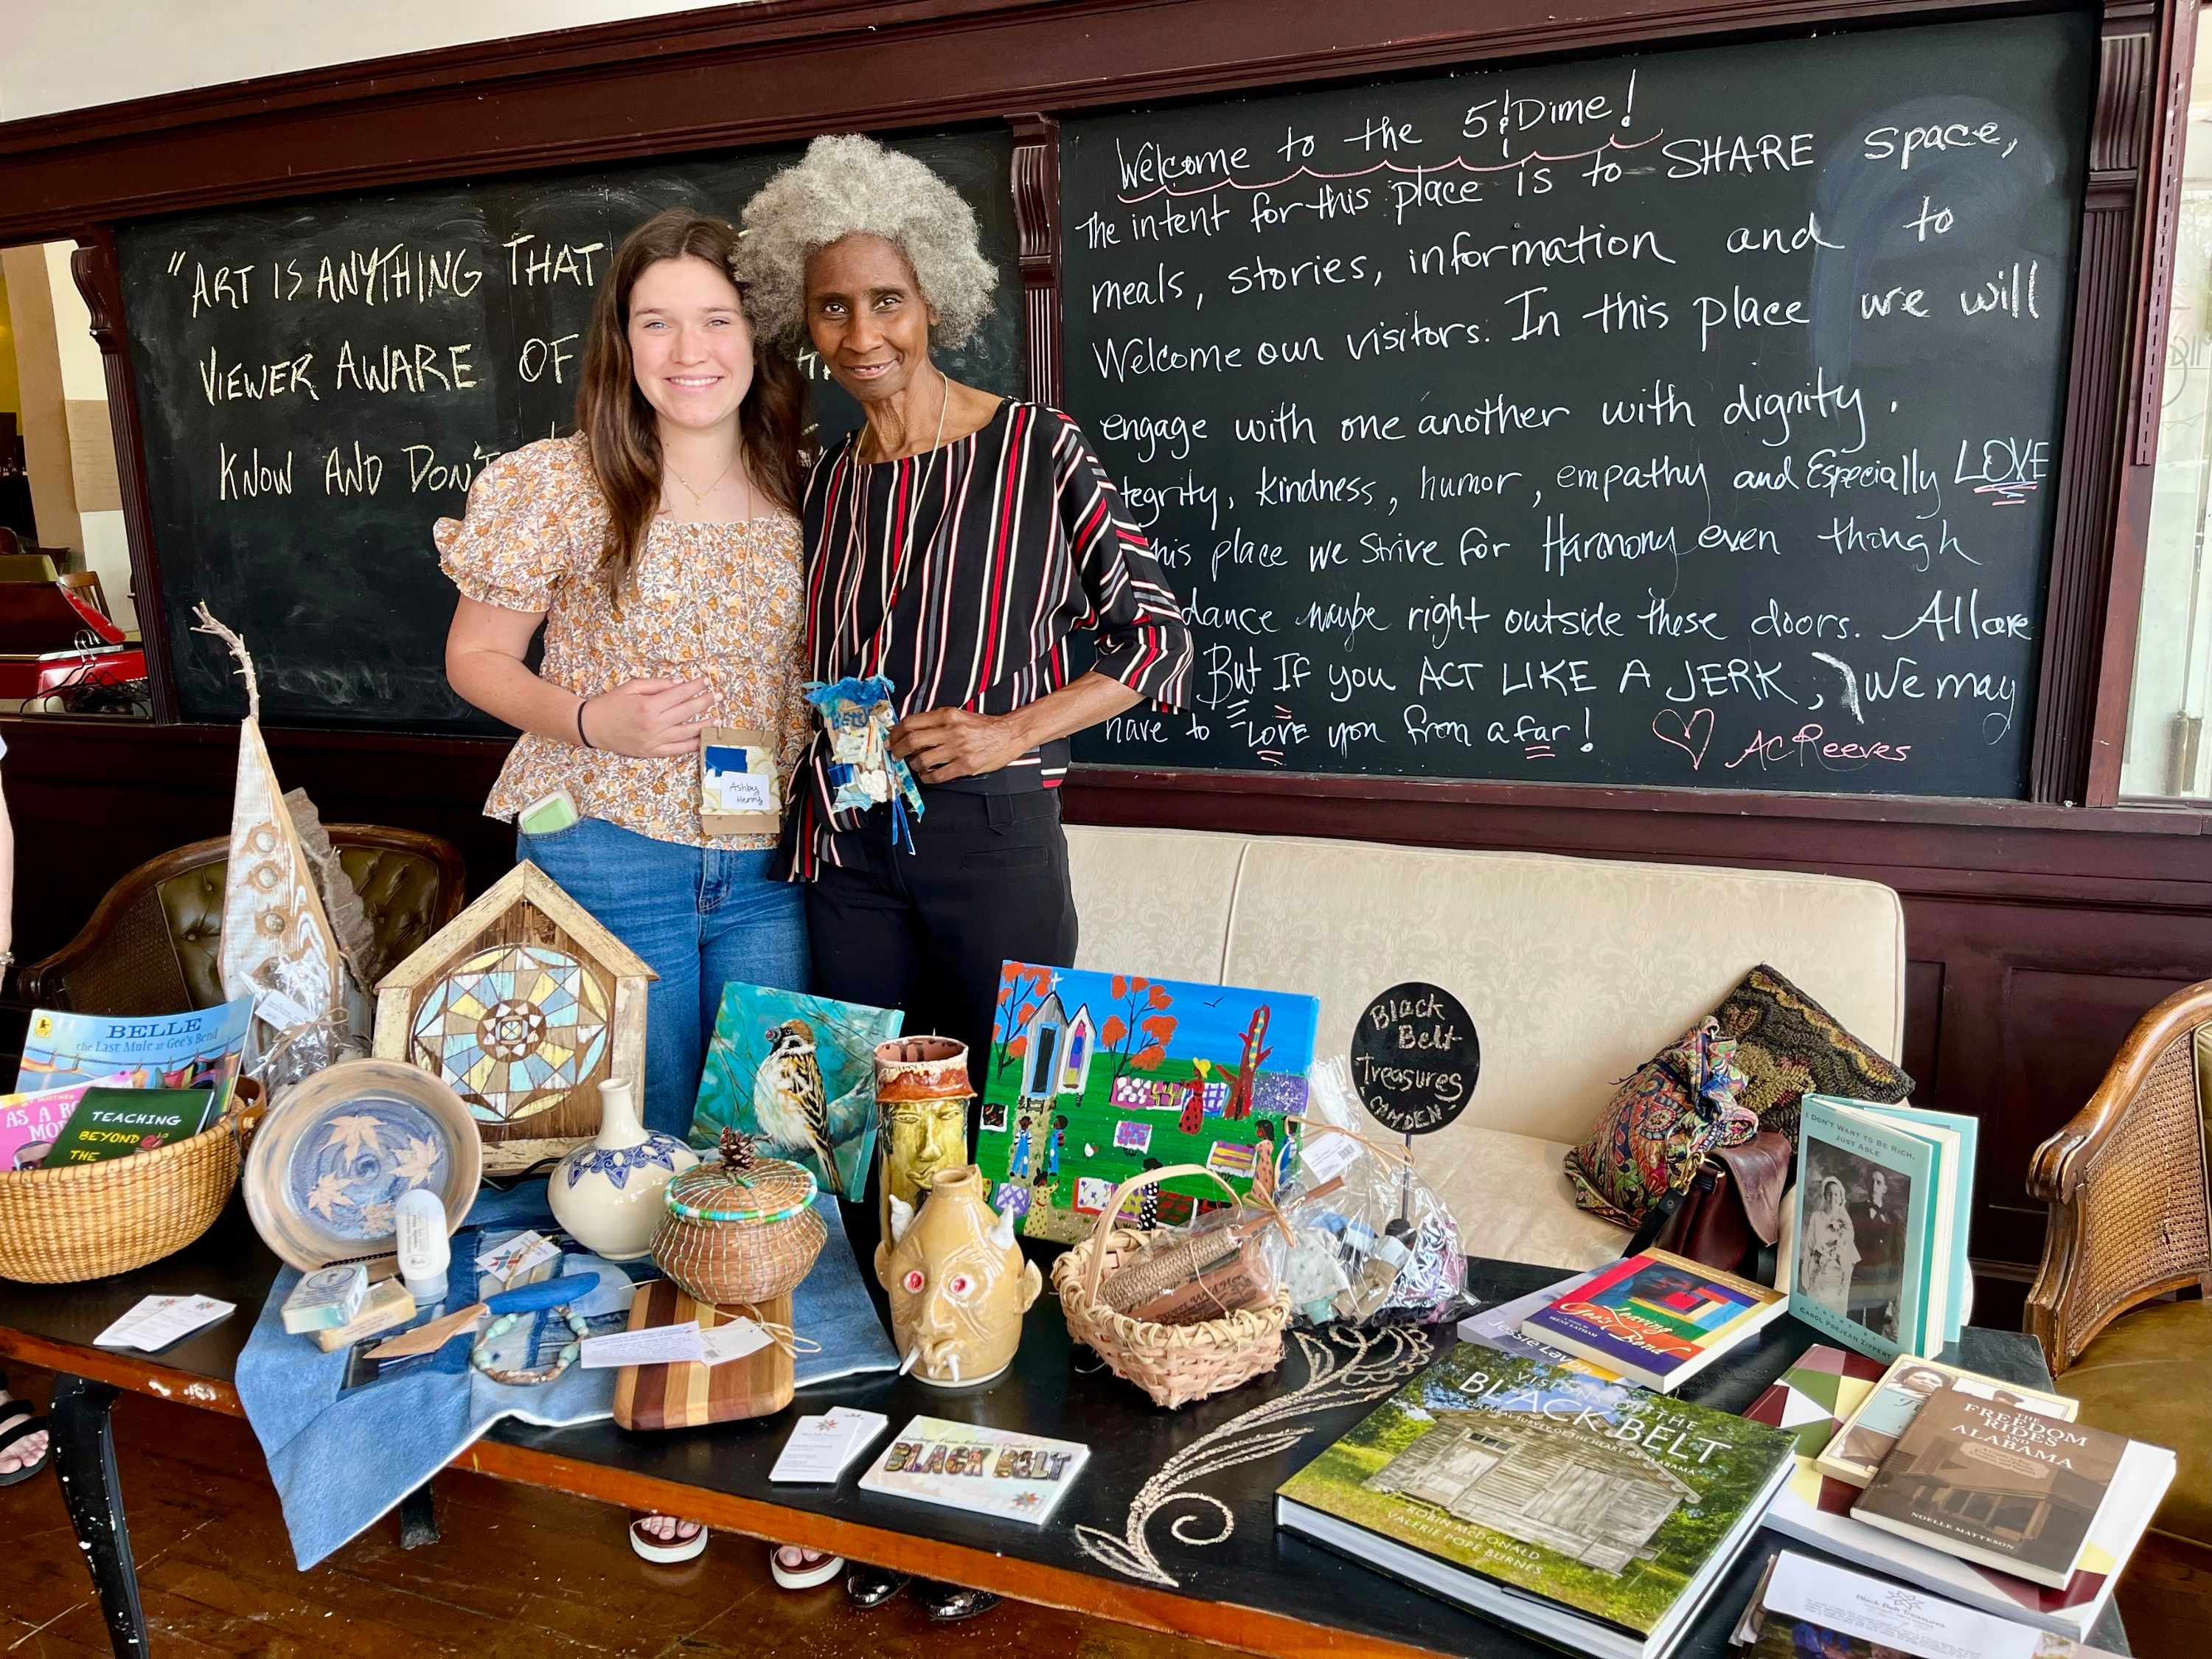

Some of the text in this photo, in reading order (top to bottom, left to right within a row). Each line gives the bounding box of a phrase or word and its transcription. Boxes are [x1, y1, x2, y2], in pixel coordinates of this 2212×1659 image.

[1116, 137, 1251, 189] Welcome
[1277, 126, 1315, 162] to
[1343, 116, 1423, 153] the
[1132, 193, 1231, 241] intent
[1251, 201, 1302, 234] for
[1295, 183, 1371, 223] this
[1395, 164, 1484, 226] place
[1517, 161, 1553, 197] is
[1582, 150, 1622, 187] to
[1662, 133, 1815, 180] SHARE
[274, 260, 301, 302] IS
[317, 243, 483, 306] ANYTHING
[503, 234, 605, 287] THAT
[1091, 194, 1955, 311] meals, stories, information and to
[1091, 337, 1243, 383] Welcome
[1347, 310, 1492, 361] visitors.
[1504, 286, 1561, 342] In
[1582, 291, 1672, 335] this
[1692, 285, 1811, 352] place
[1861, 286, 1931, 319] we
[1959, 260, 2040, 319] will
[198, 333, 580, 407] VIEWER AWARE OF
[1099, 360, 1899, 462] engage with one another with dignity.
[220, 442, 293, 501] KNOW
[325, 440, 383, 497] AND
[1119, 469, 1235, 531] tegrity,
[1256, 465, 1398, 517] kindness,
[1420, 465, 1542, 508] humor,
[1557, 454, 1711, 526] empathy
[1733, 456, 1792, 490] and
[1954, 439, 2050, 486] LOVE
[1146, 538, 1192, 568] his
[1211, 527, 1288, 582] place
[1460, 527, 1511, 566] for
[1543, 512, 1679, 584] Harmony
[1698, 524, 1781, 555] even
[1181, 587, 1281, 634] dance
[1408, 594, 1490, 649] right
[1505, 596, 1624, 636] outside
[1750, 598, 1860, 639] doors.
[1197, 643, 1262, 710] But
[1328, 664, 1397, 702] you
[1419, 656, 1484, 695] ACT
[1503, 660, 1598, 698] LIKE
[1620, 660, 1651, 693] A
[1936, 673, 2015, 731] may
[1186, 712, 1210, 740] to
[1404, 704, 1472, 748] from
[105, 1018, 202, 1039] BELLE
[1369, 992, 1446, 1031] Black
[76, 1028, 219, 1052] the Last Mule at Gee's Bend
[1398, 1024, 1464, 1051] Belt
[6, 1109, 29, 1128] AS
[38, 1105, 51, 1123] A
[79, 1130, 142, 1144] BEYOND
[92, 1110, 183, 1126] TEACHING
[69, 1149, 102, 1162] THE
[1486, 1320, 1540, 1348] Jessie
[1557, 1301, 1614, 1324] Gee's
[1602, 1305, 1673, 1335] Leaving
[1601, 1325, 1691, 1356] Bend
[1458, 1371, 1733, 1464] BLACK BELT
[1518, 1371, 1602, 1403] VISIONS
[1656, 1411, 1699, 1431] THE
[2015, 1412, 2041, 1424] THE
[1514, 1415, 1553, 1433] SURVEY
[1590, 1439, 1626, 1454] HEART
[1644, 1455, 1695, 1475] ALABAMA
[1963, 1402, 2089, 1447] FREEDOM
[1983, 1418, 2059, 1447] RIDES
[2002, 1433, 2031, 1446] AND
[883, 1441, 1072, 1481] BLACK BELT
[1950, 1424, 2074, 1470] ALABAMA
[1406, 1505, 1453, 1528] ROBIN
[1911, 1512, 1953, 1530] NOELLE
[1387, 1510, 1544, 1576] VALERIE POPE BURNES
